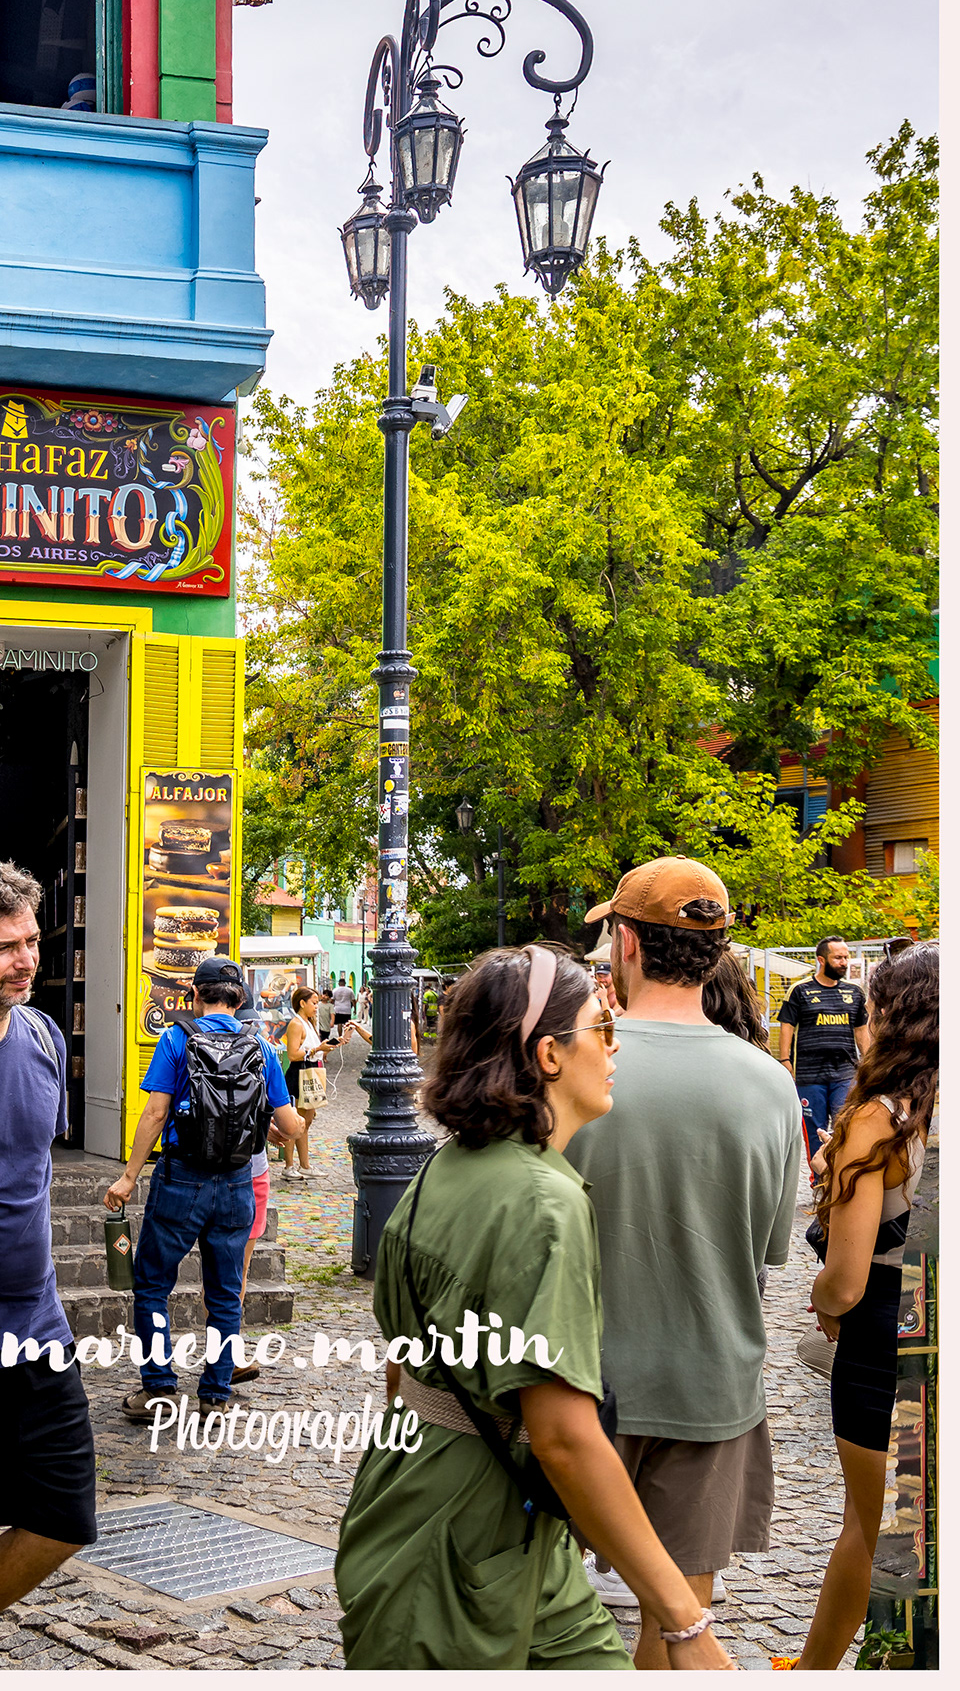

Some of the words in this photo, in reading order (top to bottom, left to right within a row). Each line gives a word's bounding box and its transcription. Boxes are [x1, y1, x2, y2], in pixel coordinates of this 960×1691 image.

[28, 547, 88, 562] AIRES
[150, 785, 227, 803] ALFAJOR
[816, 1012, 850, 1026] ANDINA
